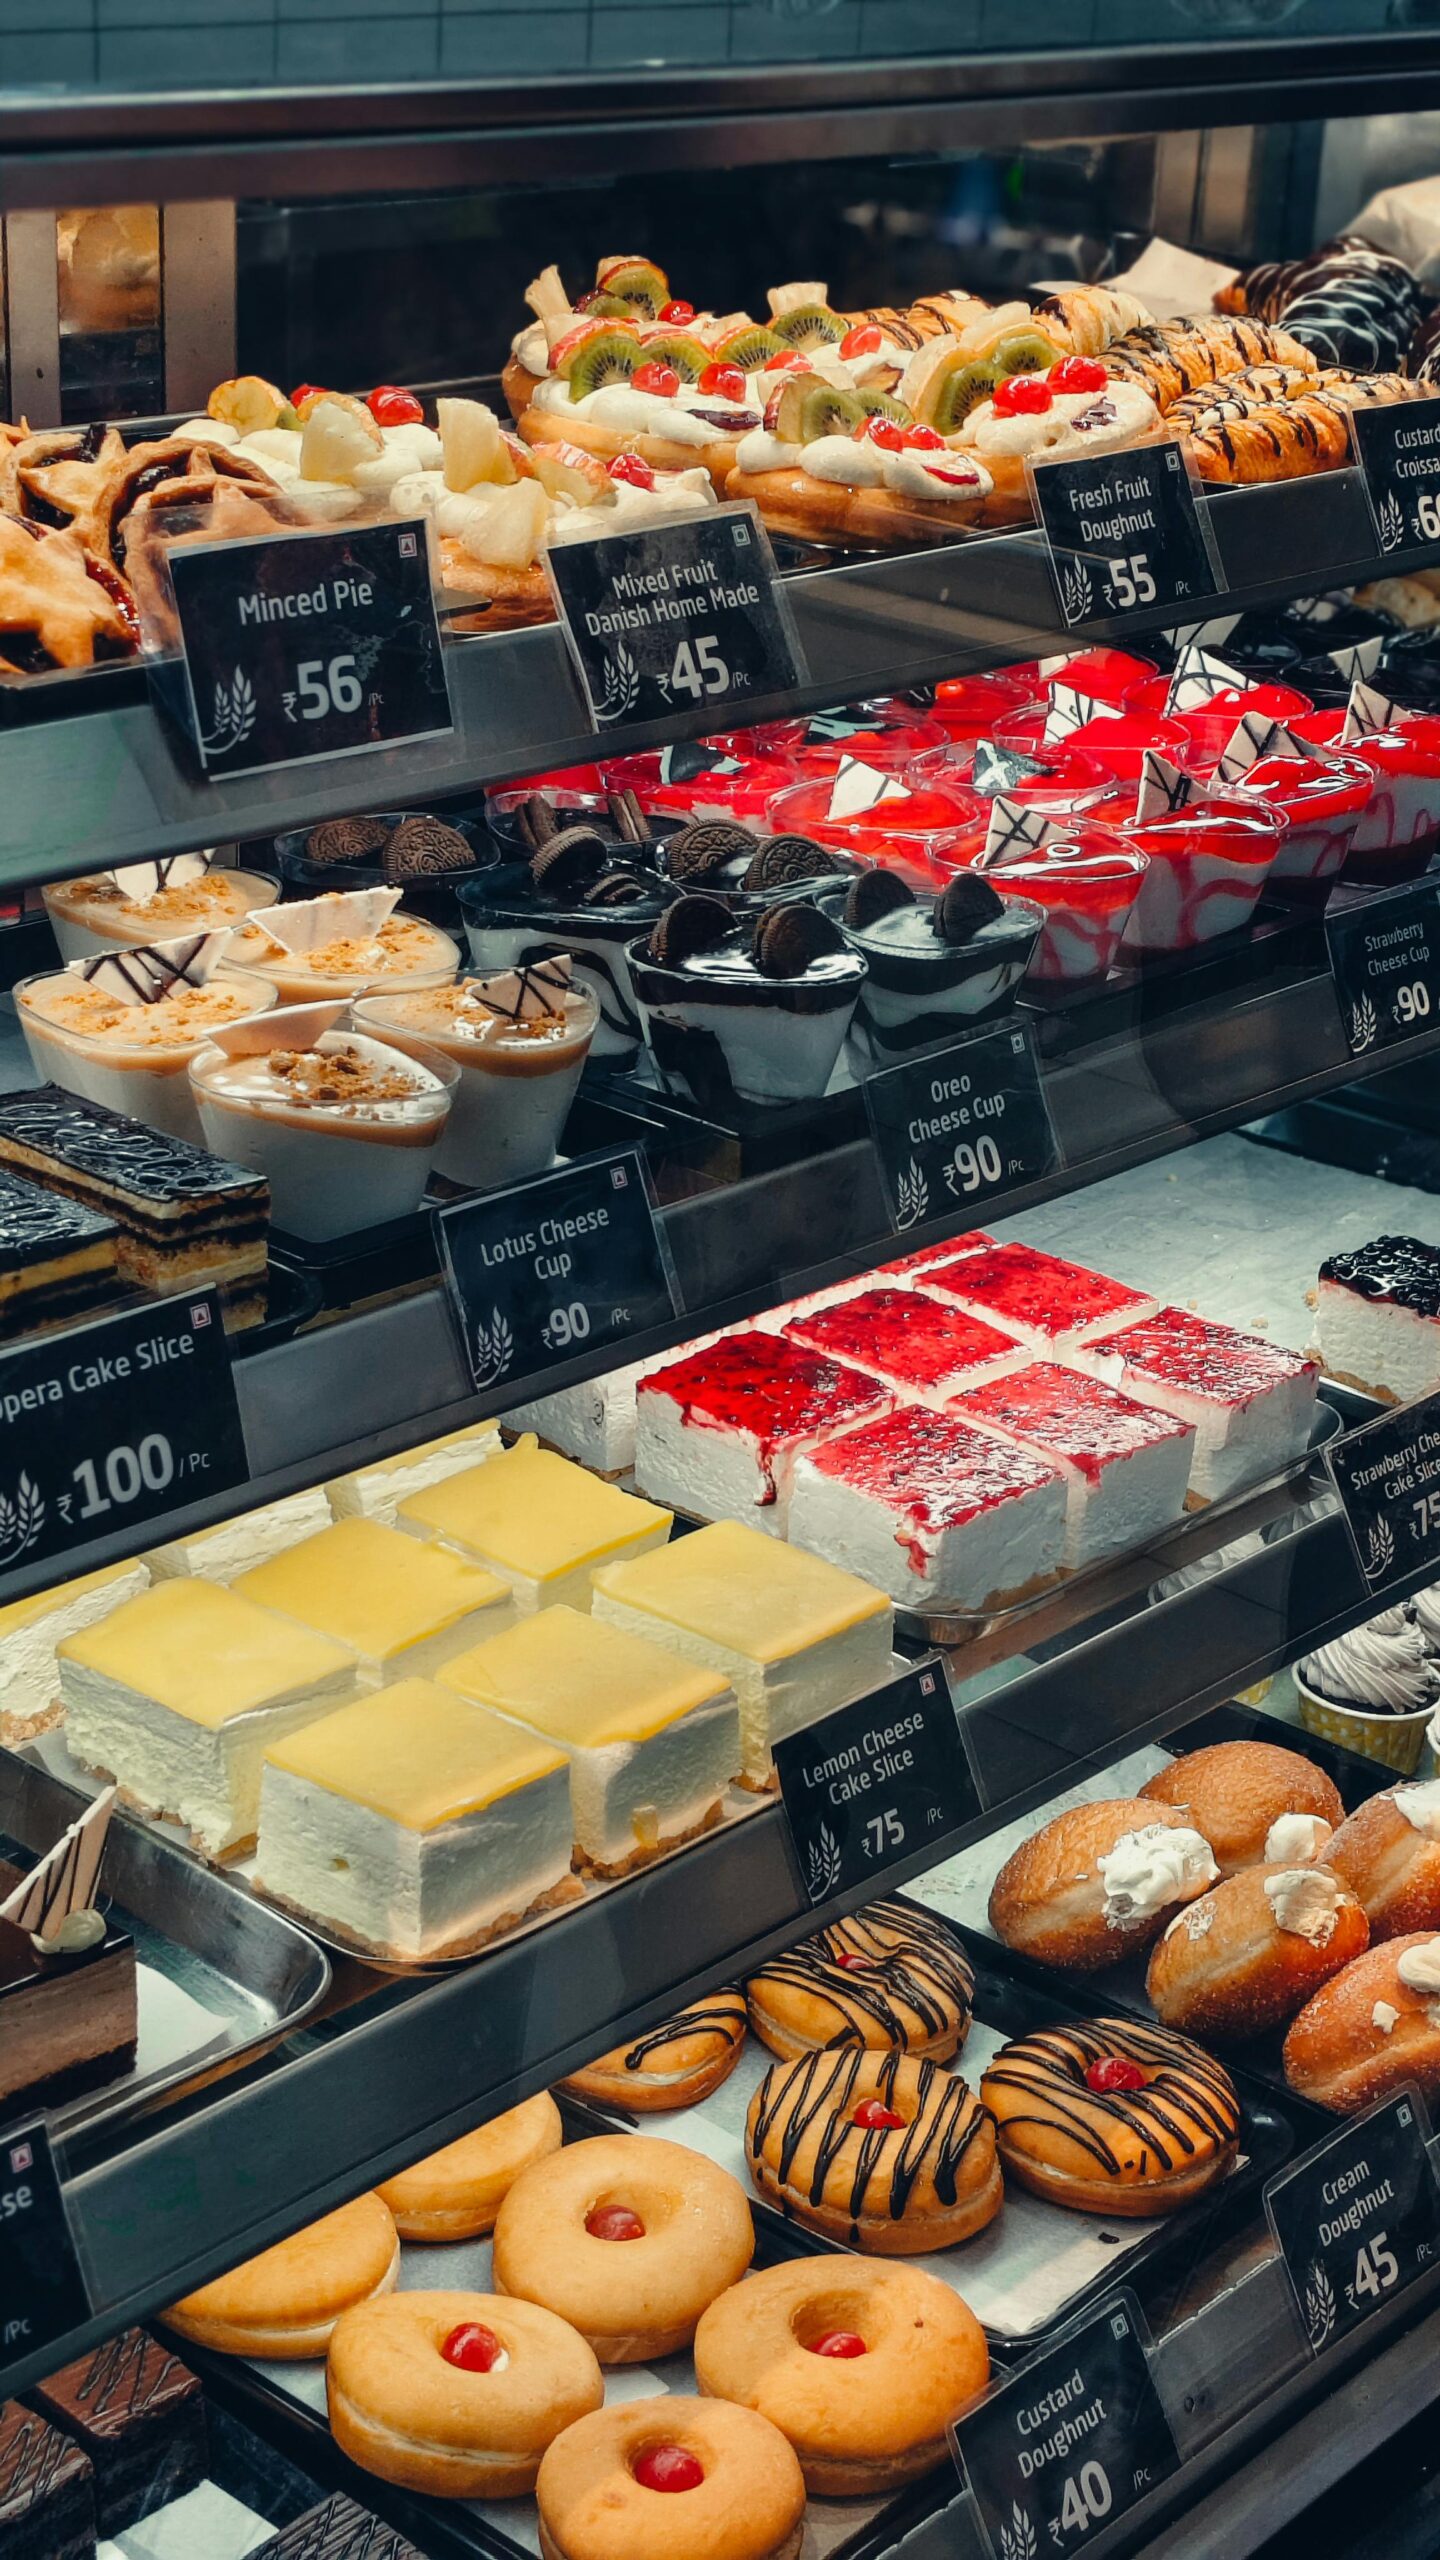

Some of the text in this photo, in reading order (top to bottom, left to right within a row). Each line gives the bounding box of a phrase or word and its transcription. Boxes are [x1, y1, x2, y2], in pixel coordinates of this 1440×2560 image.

[1069, 476, 1152, 512] Fresh Fruit
[1411, 493, 1440, 541] ₹6
[1080, 509, 1157, 542] Doughnut
[238, 579, 374, 626] Minced Pie
[612, 559, 718, 600] Mixed Fruit
[1102, 554, 1192, 610] ₹55 /Pc
[585, 582, 760, 636] Danish Home Made
[282, 655, 363, 722] ₹56
[656, 635, 751, 704] ₹45 /Pc
[1364, 922, 1424, 952] Strawberry
[1367, 945, 1430, 976] Cheese Cup
[1392, 981, 1430, 1024] ₹90
[931, 1075, 971, 1103] Oreo
[909, 1094, 1005, 1143] Cheese Cup
[942, 1135, 1024, 1196] ₹90 /Pc
[480, 1208, 610, 1267] Lotus Cheese
[534, 1252, 572, 1280] Cup
[541, 1302, 631, 1349] ₹90 /Pc
[0, 1333, 194, 1423] pera Cake Slice
[57, 1433, 174, 1524] ₹100
[1351, 1443, 1417, 1490] Strawberry
[1384, 1474, 1415, 1500] Cake
[802, 1712, 925, 1789] Lemon Cheese
[828, 1749, 915, 1805] Cake Slice
[861, 1806, 944, 1858] ₹75 /Pc
[1322, 2160, 1370, 2205] Cream
[1318, 2179, 1395, 2247] Doughnut
[1343, 2231, 1433, 2310] ₹45 /Pc
[4, 2319, 32, 2344] /Pc
[1016, 2368, 1086, 2436] Custard
[1017, 2398, 1107, 2479] Doughnut
[1047, 2460, 1151, 2547] ₹40 /Pc
